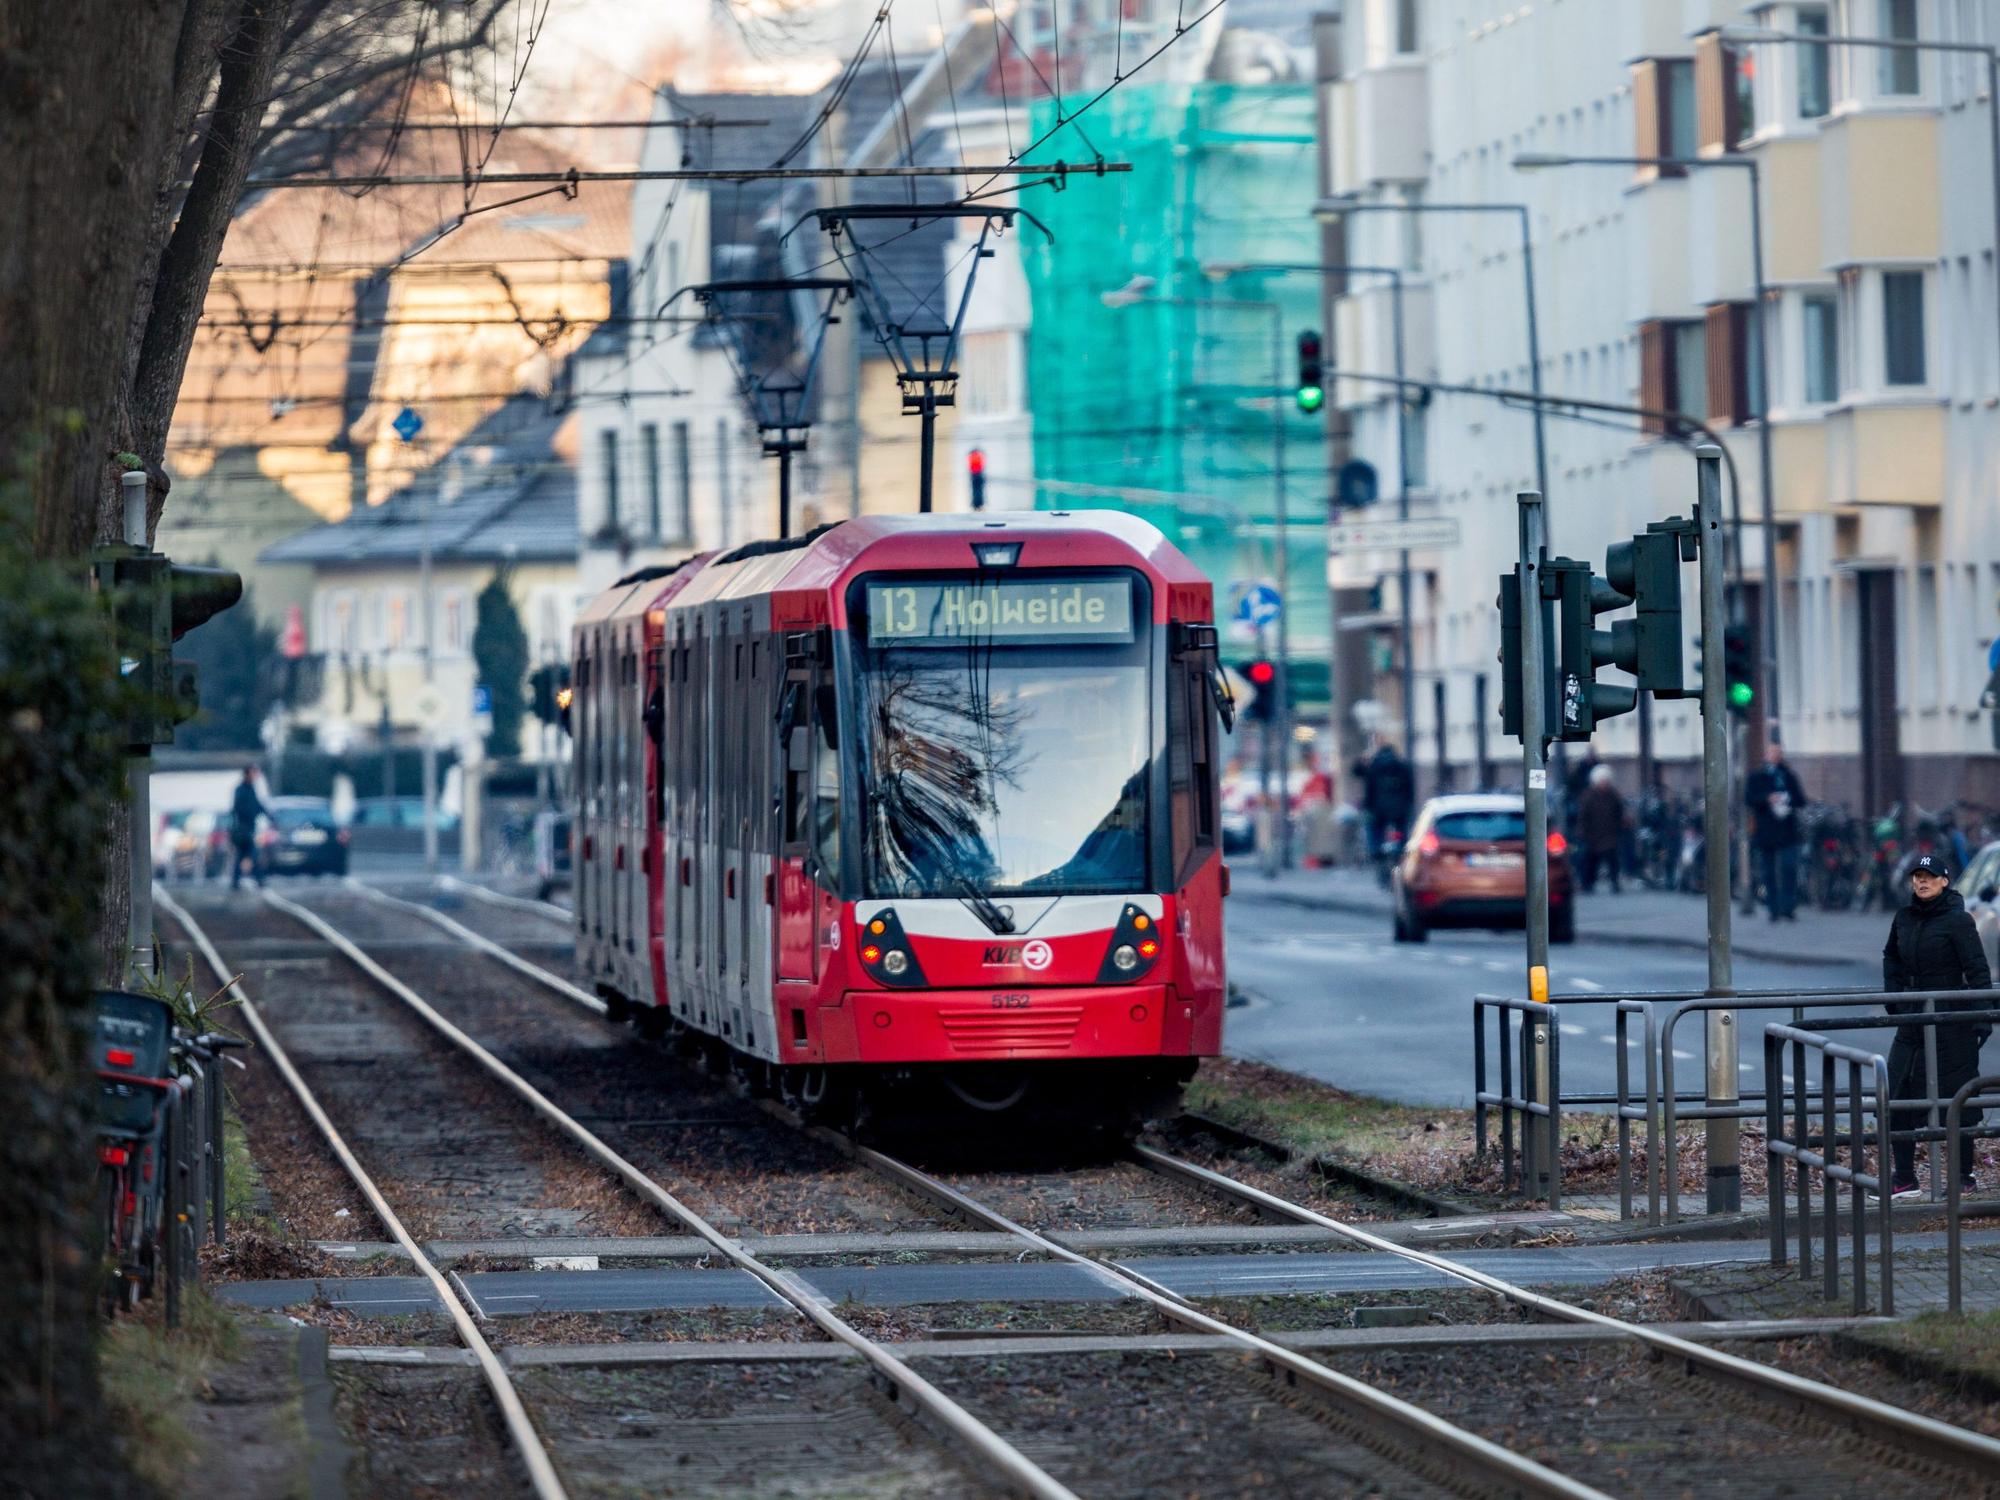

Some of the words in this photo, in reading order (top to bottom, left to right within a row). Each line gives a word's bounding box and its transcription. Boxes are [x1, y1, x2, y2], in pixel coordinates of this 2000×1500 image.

[882, 588, 917, 632] 13
[944, 587, 1105, 625] Holweide
[982, 946, 1021, 964] KVB
[992, 994, 1030, 1008] 5152
